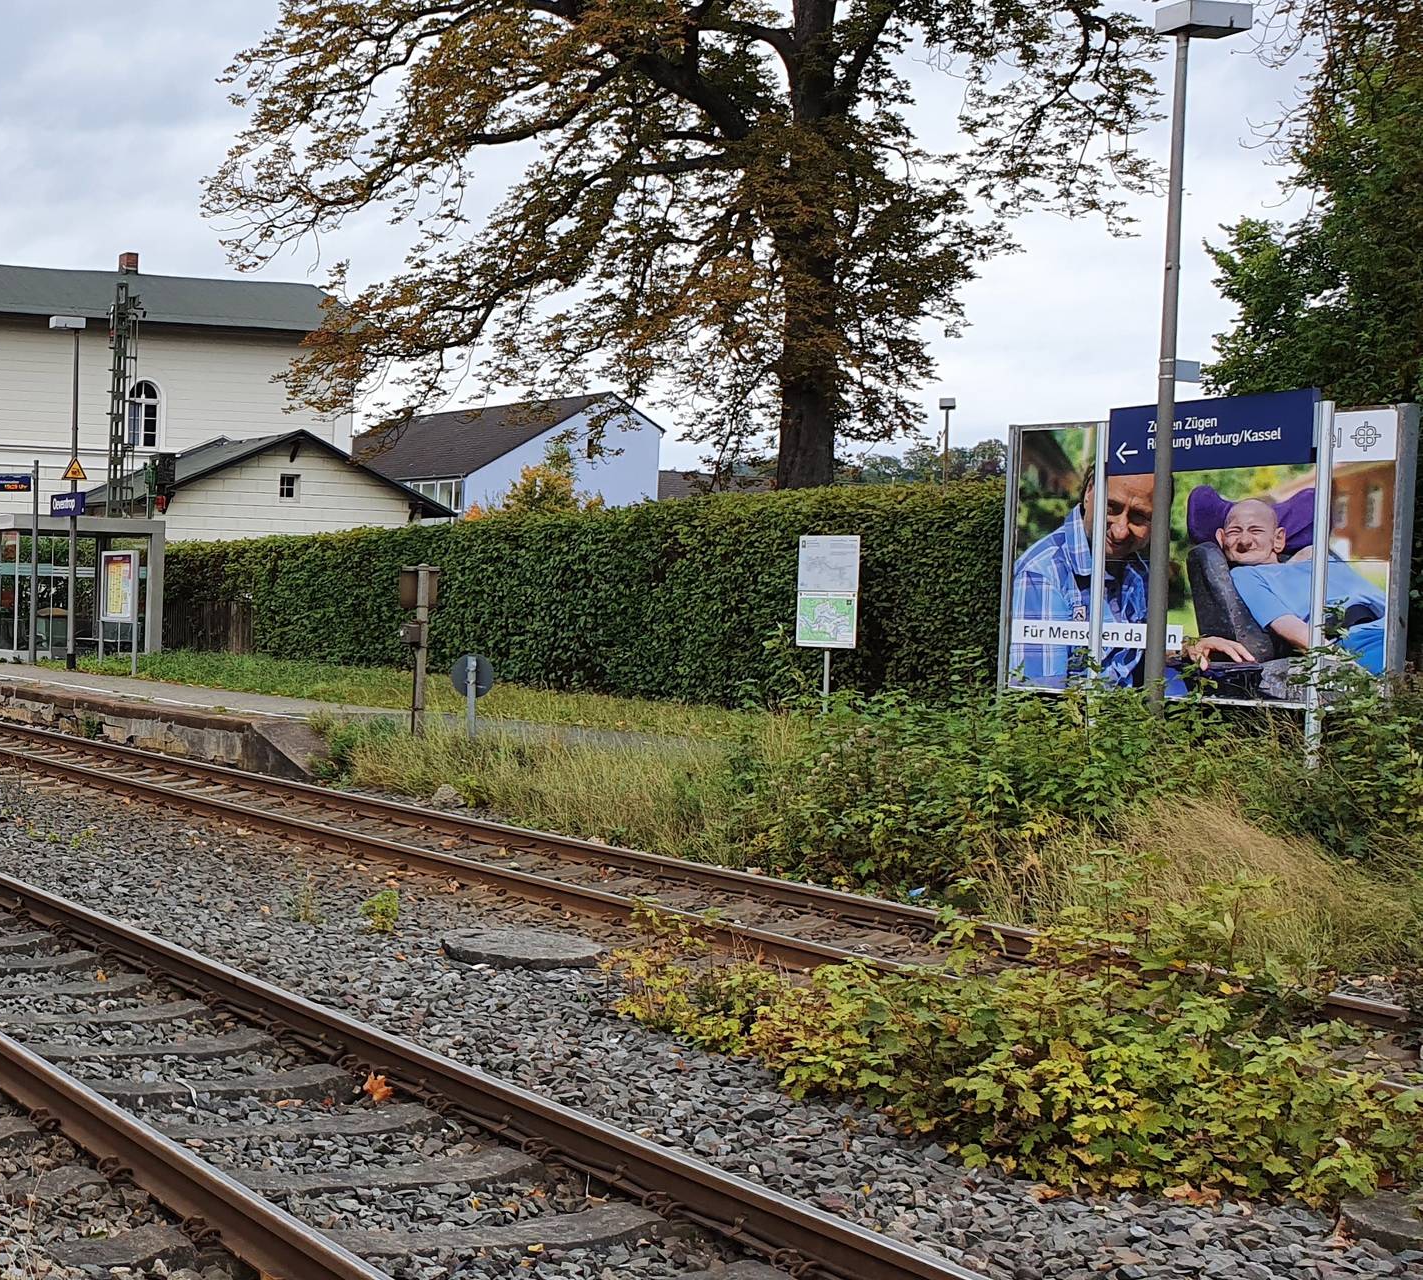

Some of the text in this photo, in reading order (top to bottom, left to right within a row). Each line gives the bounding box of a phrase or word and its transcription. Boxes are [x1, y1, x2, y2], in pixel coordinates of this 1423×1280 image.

[1184, 416, 1218, 431] Zügen
[1147, 426, 1281, 450] Rung Warburg/Kassel
[52, 497, 76, 511] Oeventrop
[1023, 625, 1142, 642] Für Menscen da
